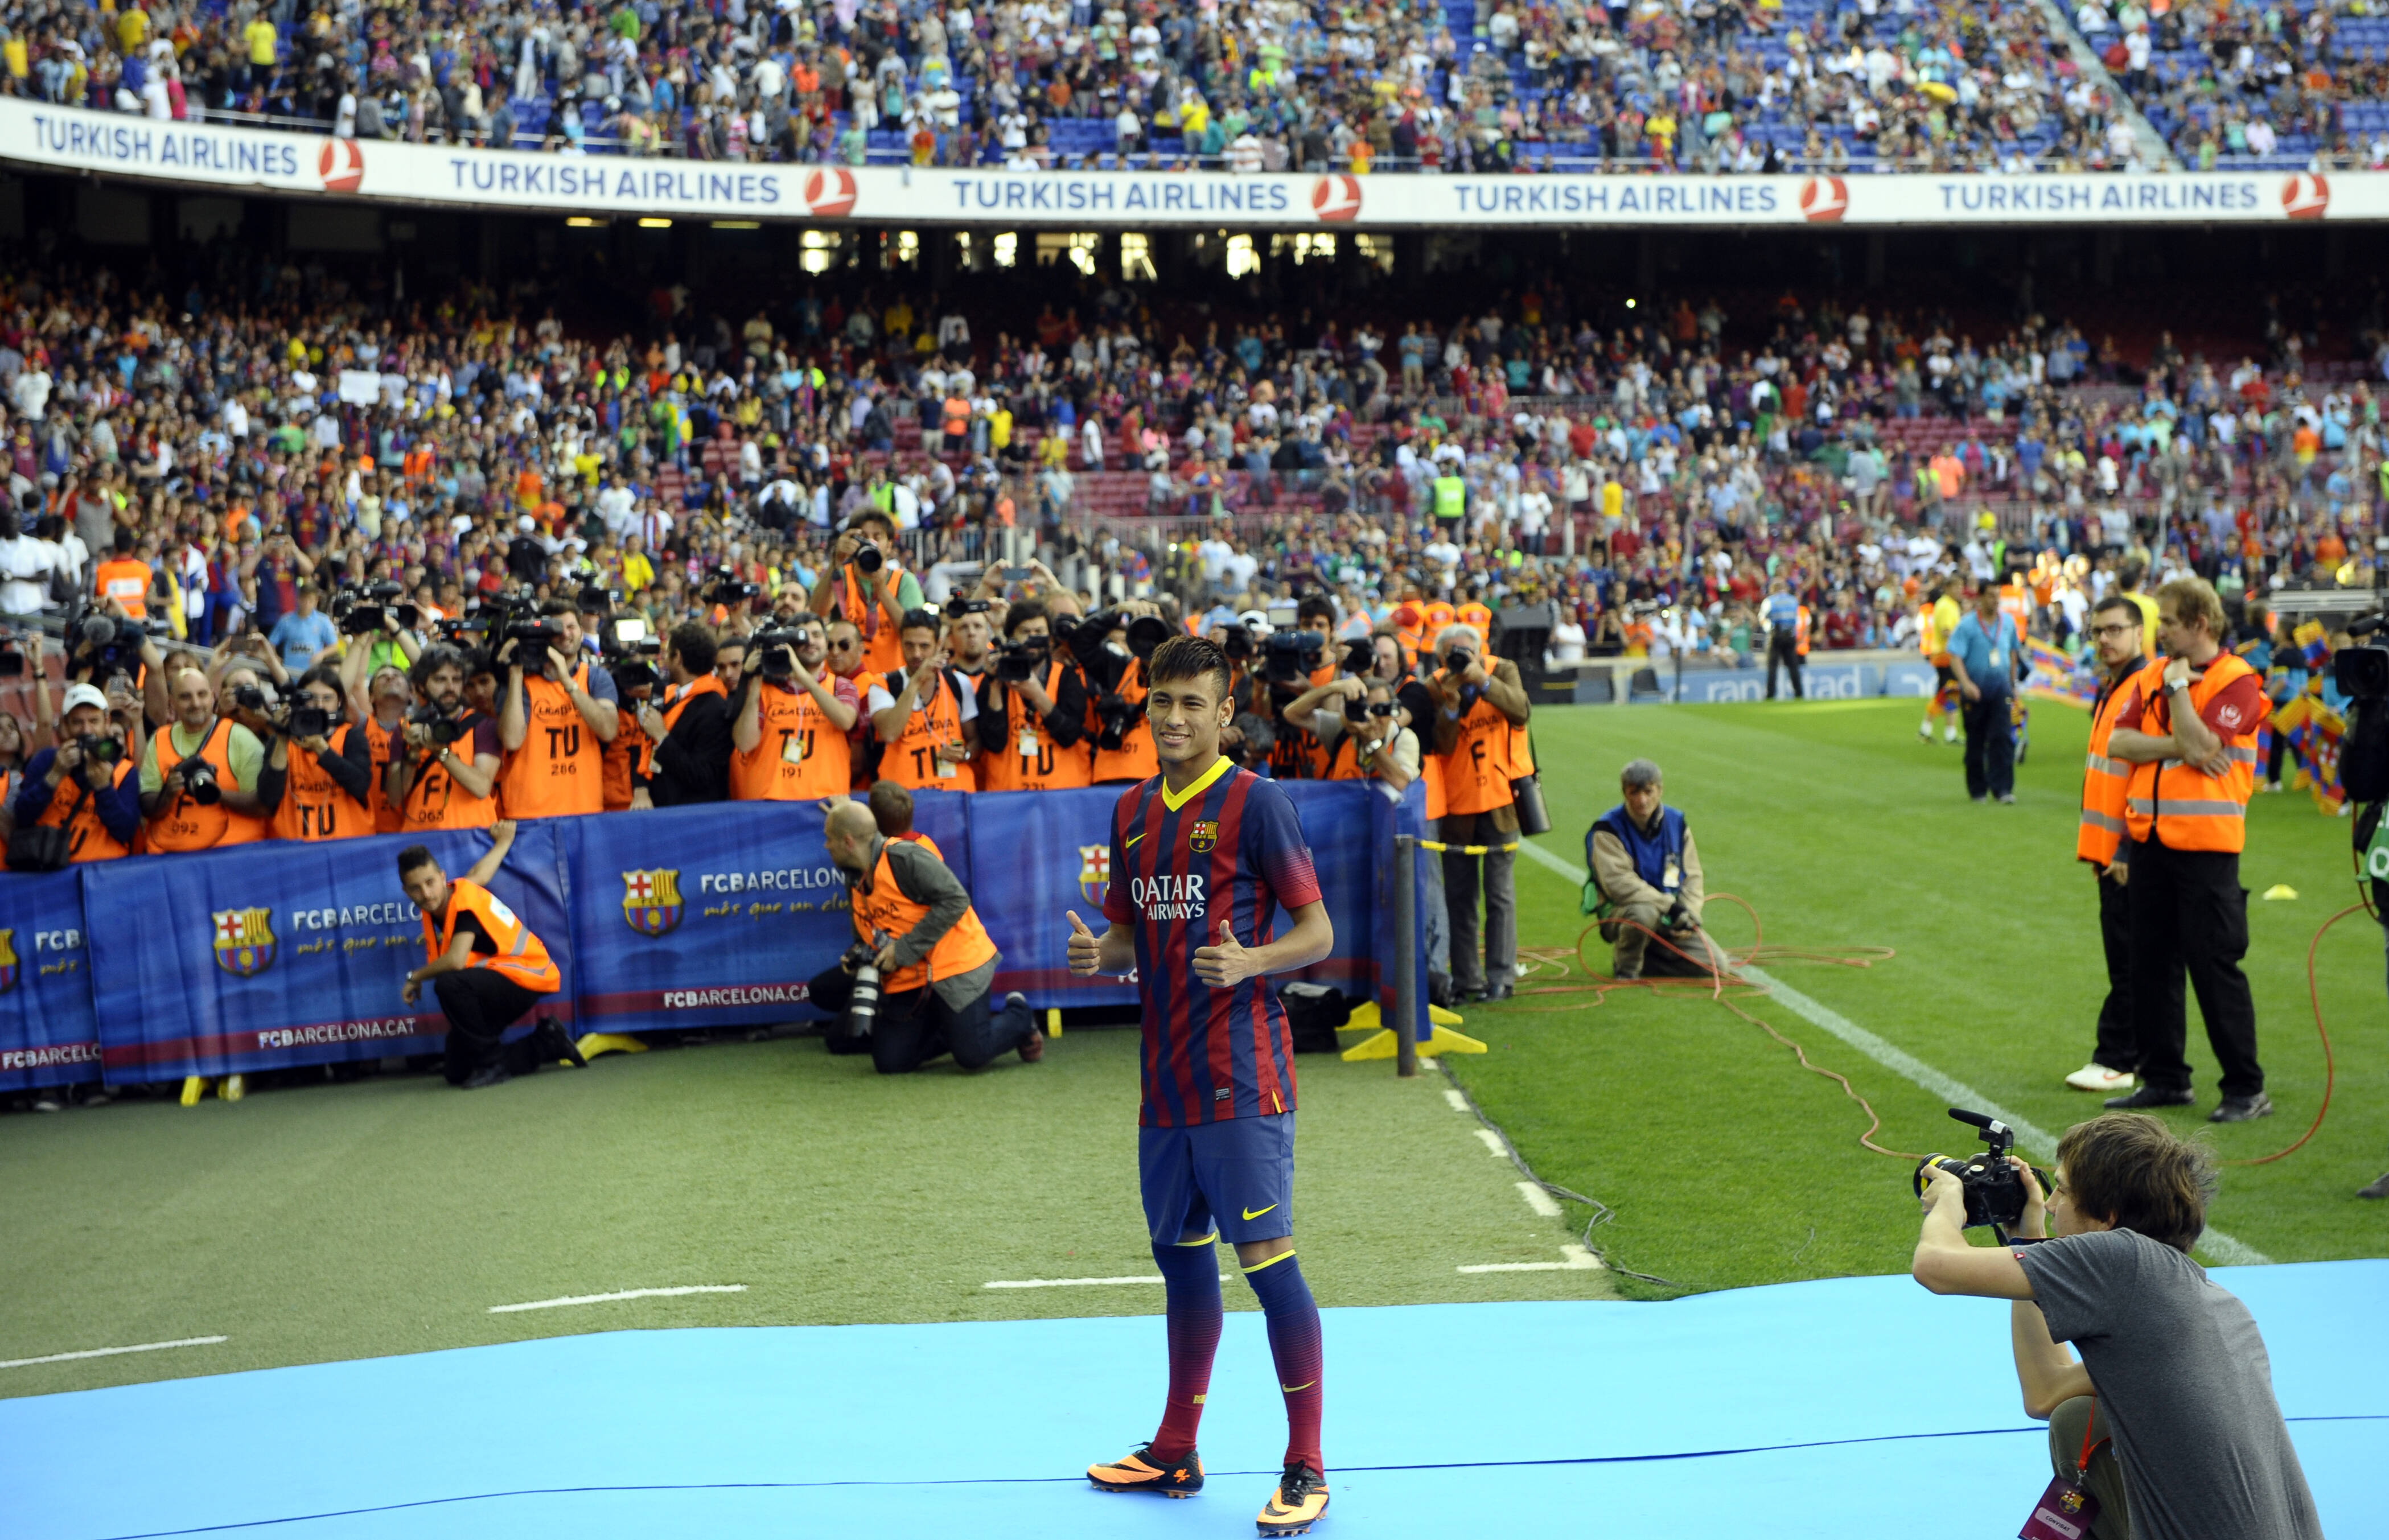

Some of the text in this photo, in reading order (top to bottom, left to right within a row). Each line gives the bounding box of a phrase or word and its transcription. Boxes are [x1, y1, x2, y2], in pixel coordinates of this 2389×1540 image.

[34, 116, 298, 175] TURKISH AIRLINES
[450, 158, 780, 203] TURKISH AIRLINES
[952, 179, 1289, 211] TURKISH AIRLINES
[1453, 184, 1777, 212] TURKISH AIRLINES
[1939, 183, 2259, 210] TURKISH AIRLINES
[545, 724, 579, 759] TU
[778, 729, 815, 760] TU
[1470, 740, 1486, 772] F
[782, 767, 801, 778] 191
[423, 774, 441, 806] F
[297, 804, 335, 837] TU
[701, 866, 846, 894] FCBARCELON
[1131, 874, 1206, 909] QATAR
[821, 892, 850, 911] clu
[1147, 903, 1205, 920] AIRWAYS
[35, 929, 81, 953] FCB
[258, 1017, 416, 1049] FCBARCELONA.CAT
[2045, 1515, 2071, 1533] CONVIDAT
